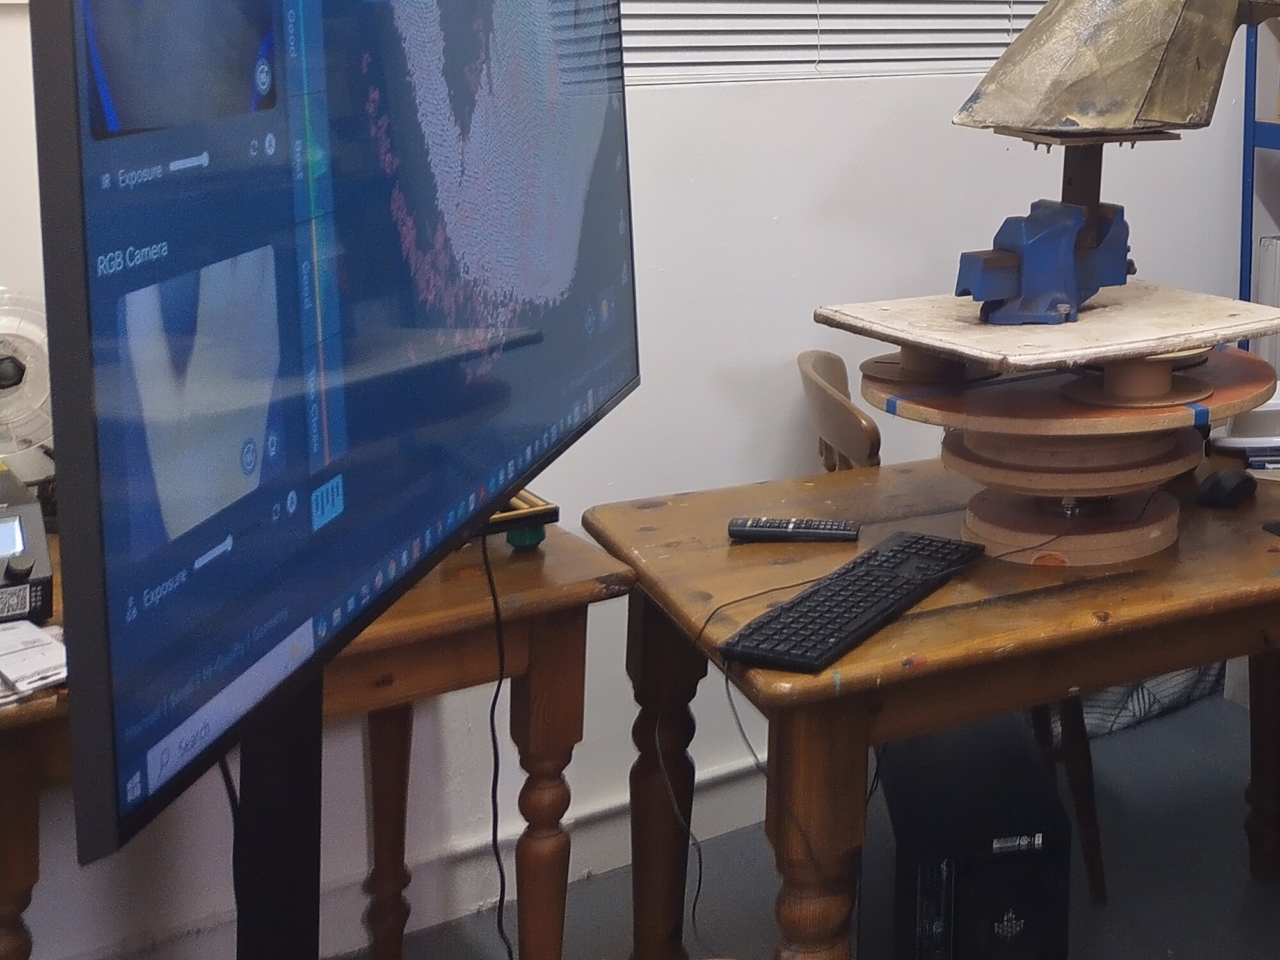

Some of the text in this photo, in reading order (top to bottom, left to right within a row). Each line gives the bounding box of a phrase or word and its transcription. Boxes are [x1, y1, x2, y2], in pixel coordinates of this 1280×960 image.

[287, 8, 298, 58] Good
[118, 164, 163, 190] Exposure
[293, 138, 304, 180] Best
[97, 240, 169, 278] RGB Camera
[301, 259, 312, 310] Good
[143, 569, 188, 611] Exposure
[177, 720, 212, 758] Search
